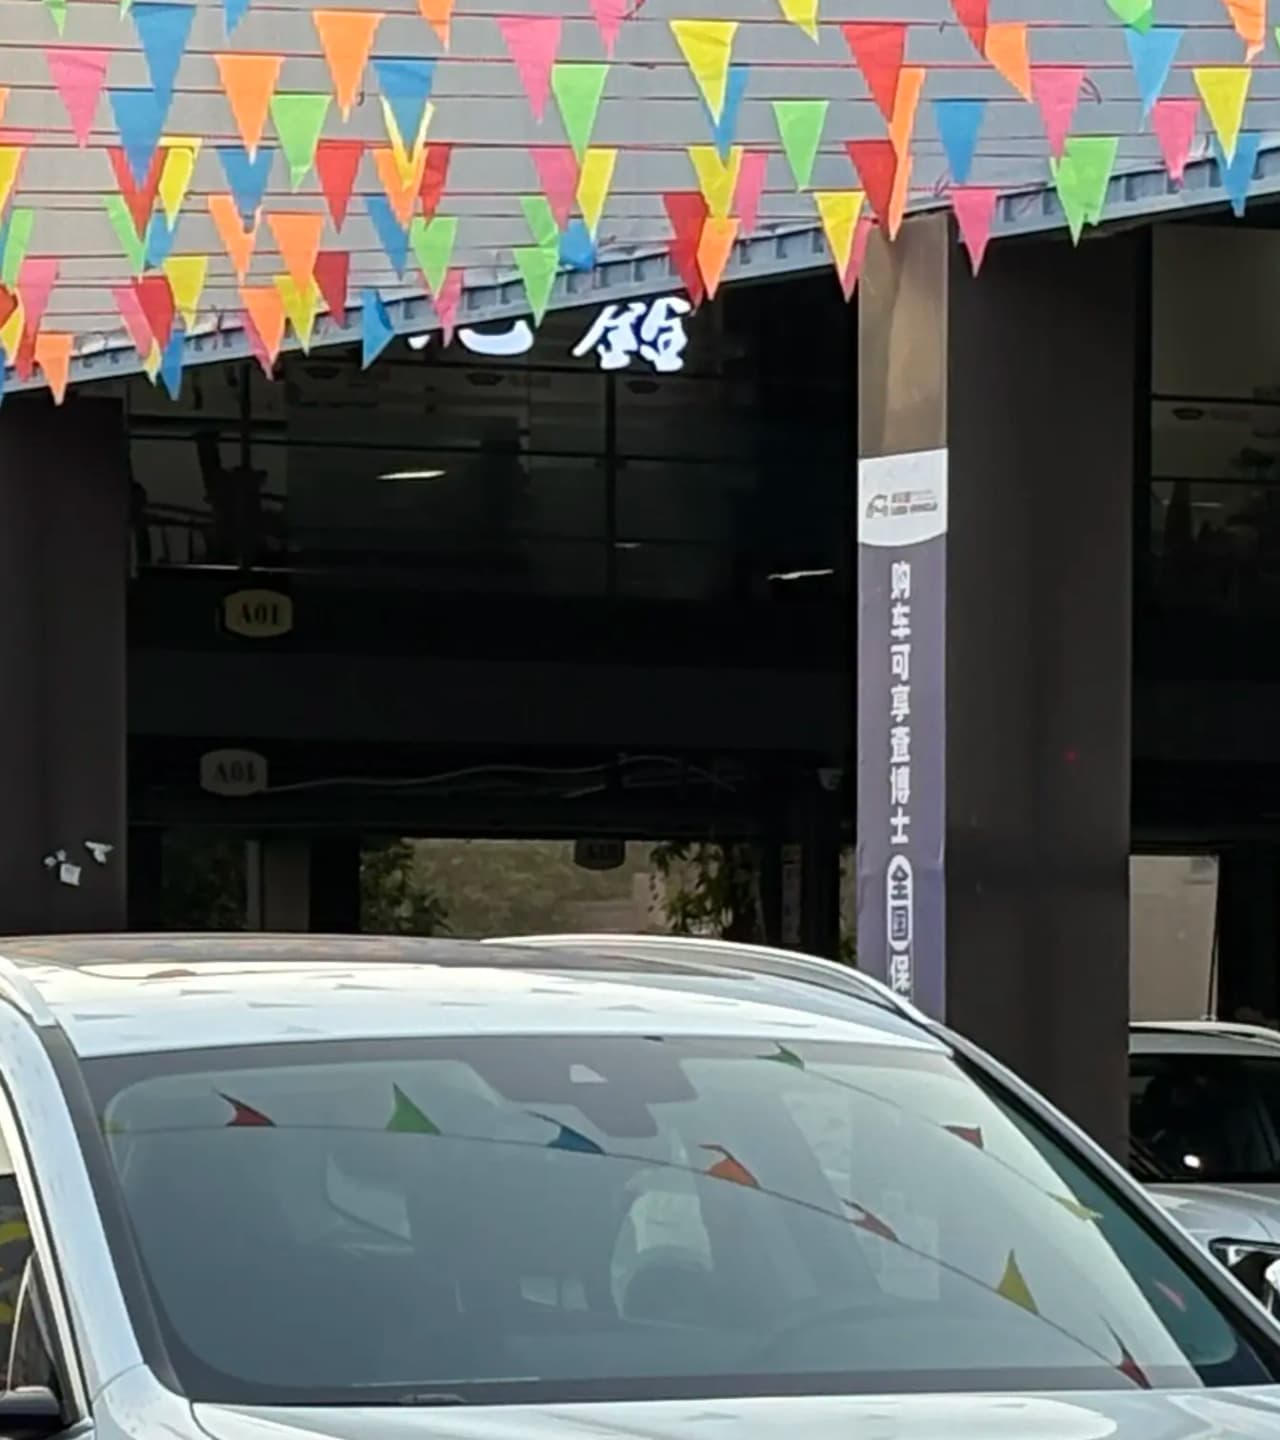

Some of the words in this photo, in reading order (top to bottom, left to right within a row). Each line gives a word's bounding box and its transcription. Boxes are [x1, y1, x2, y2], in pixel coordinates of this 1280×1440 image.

[239, 602, 279, 626] A01
[890, 560, 912, 845] 购车可享查博士
